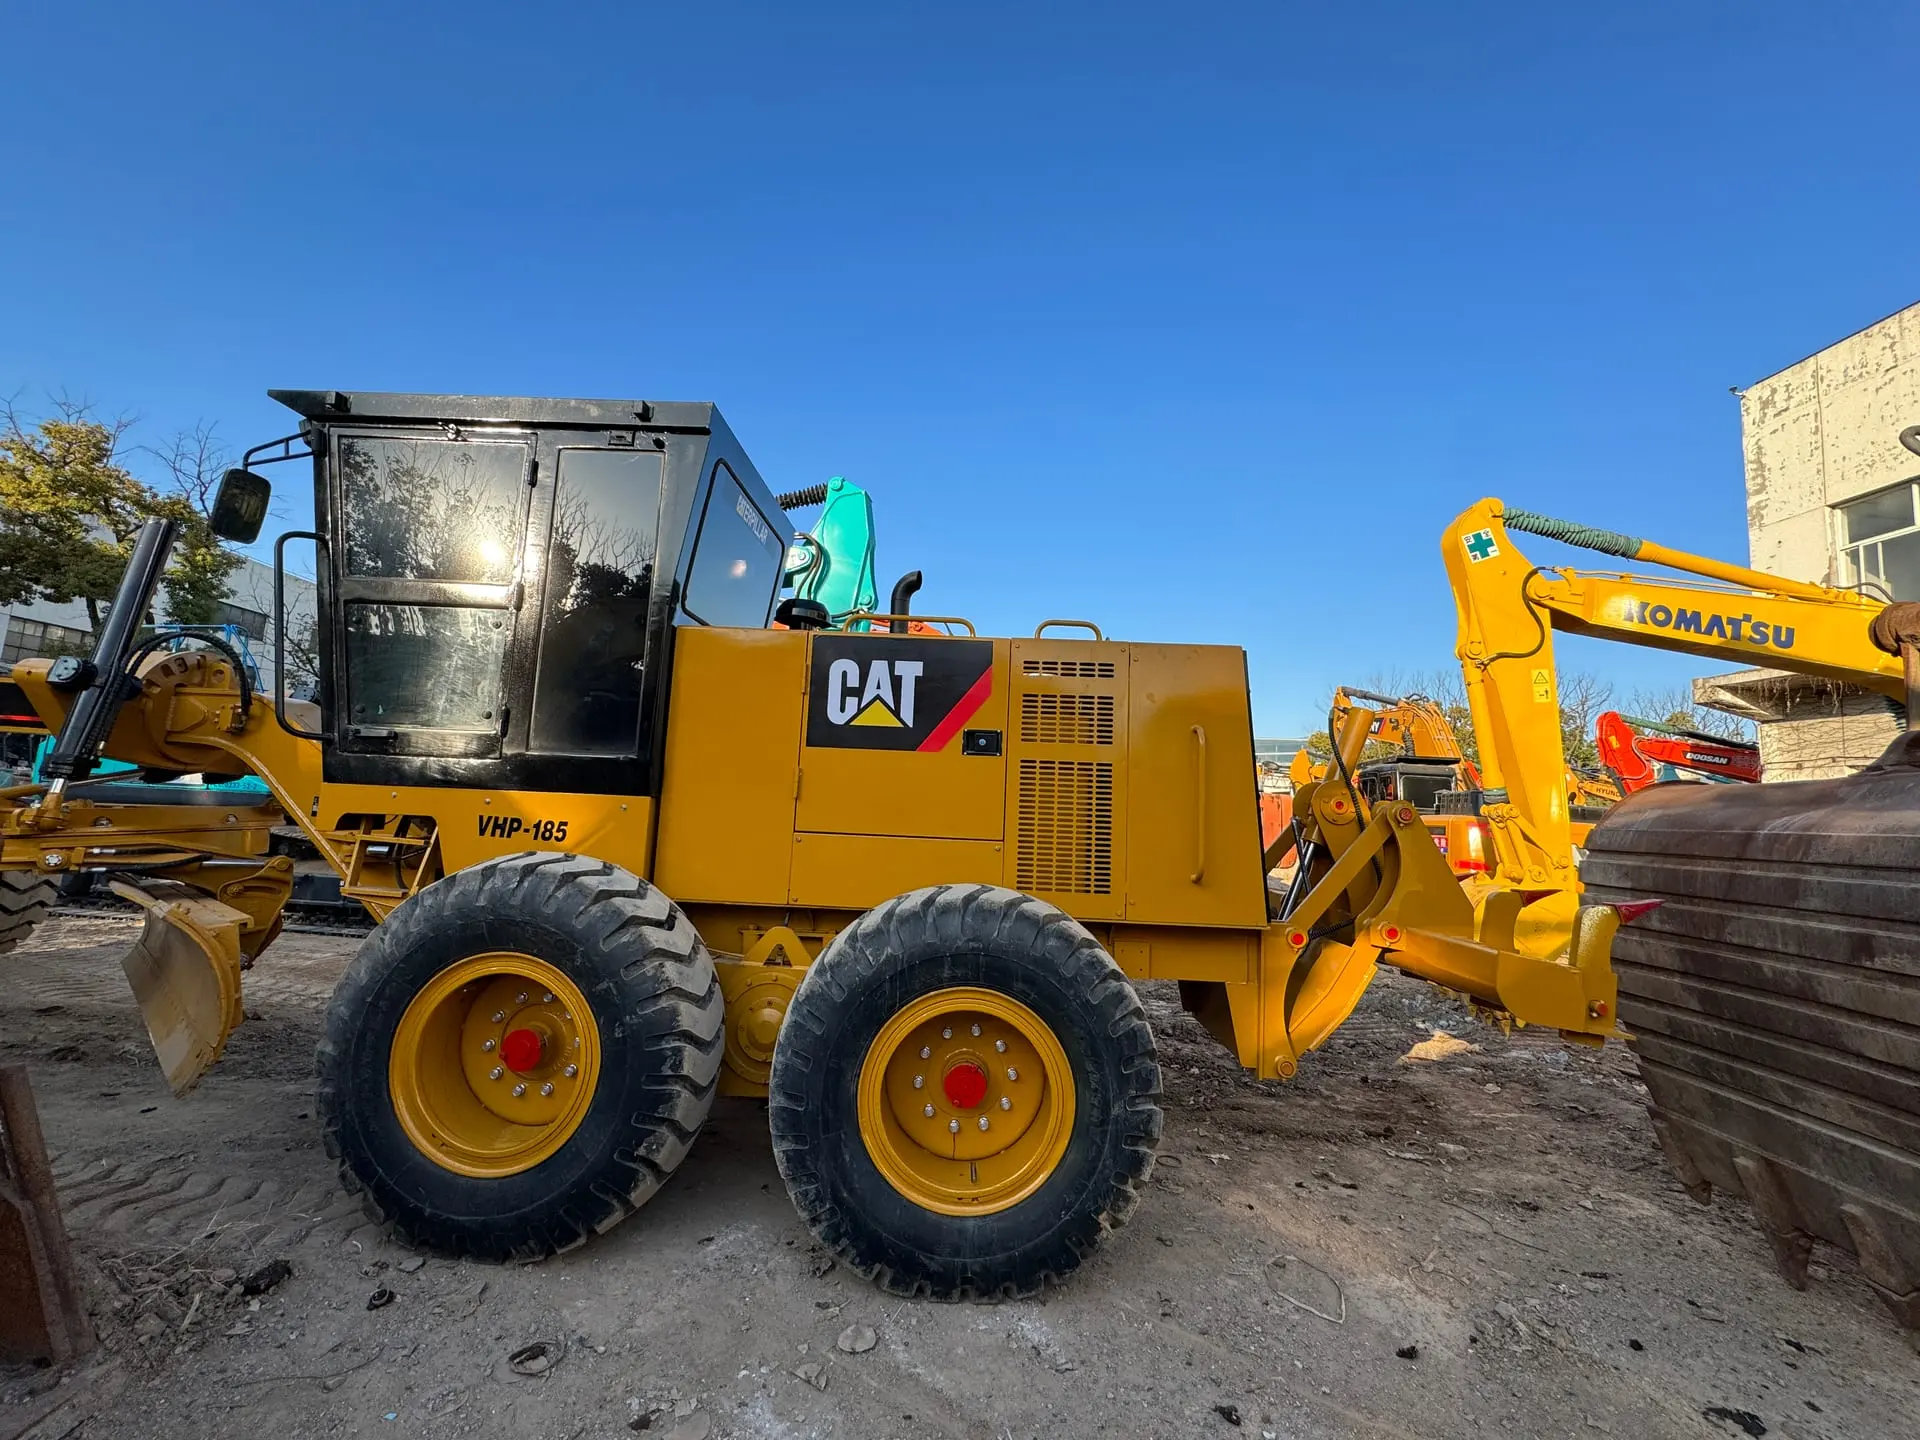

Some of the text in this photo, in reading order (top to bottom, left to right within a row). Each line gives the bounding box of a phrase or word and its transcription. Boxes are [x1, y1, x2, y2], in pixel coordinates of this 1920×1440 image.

[1623, 600, 1795, 649] KOMATSU
[827, 659, 923, 728] CAT
[1686, 752, 1728, 764] DOOSAN
[479, 815, 568, 842] VHP-185
